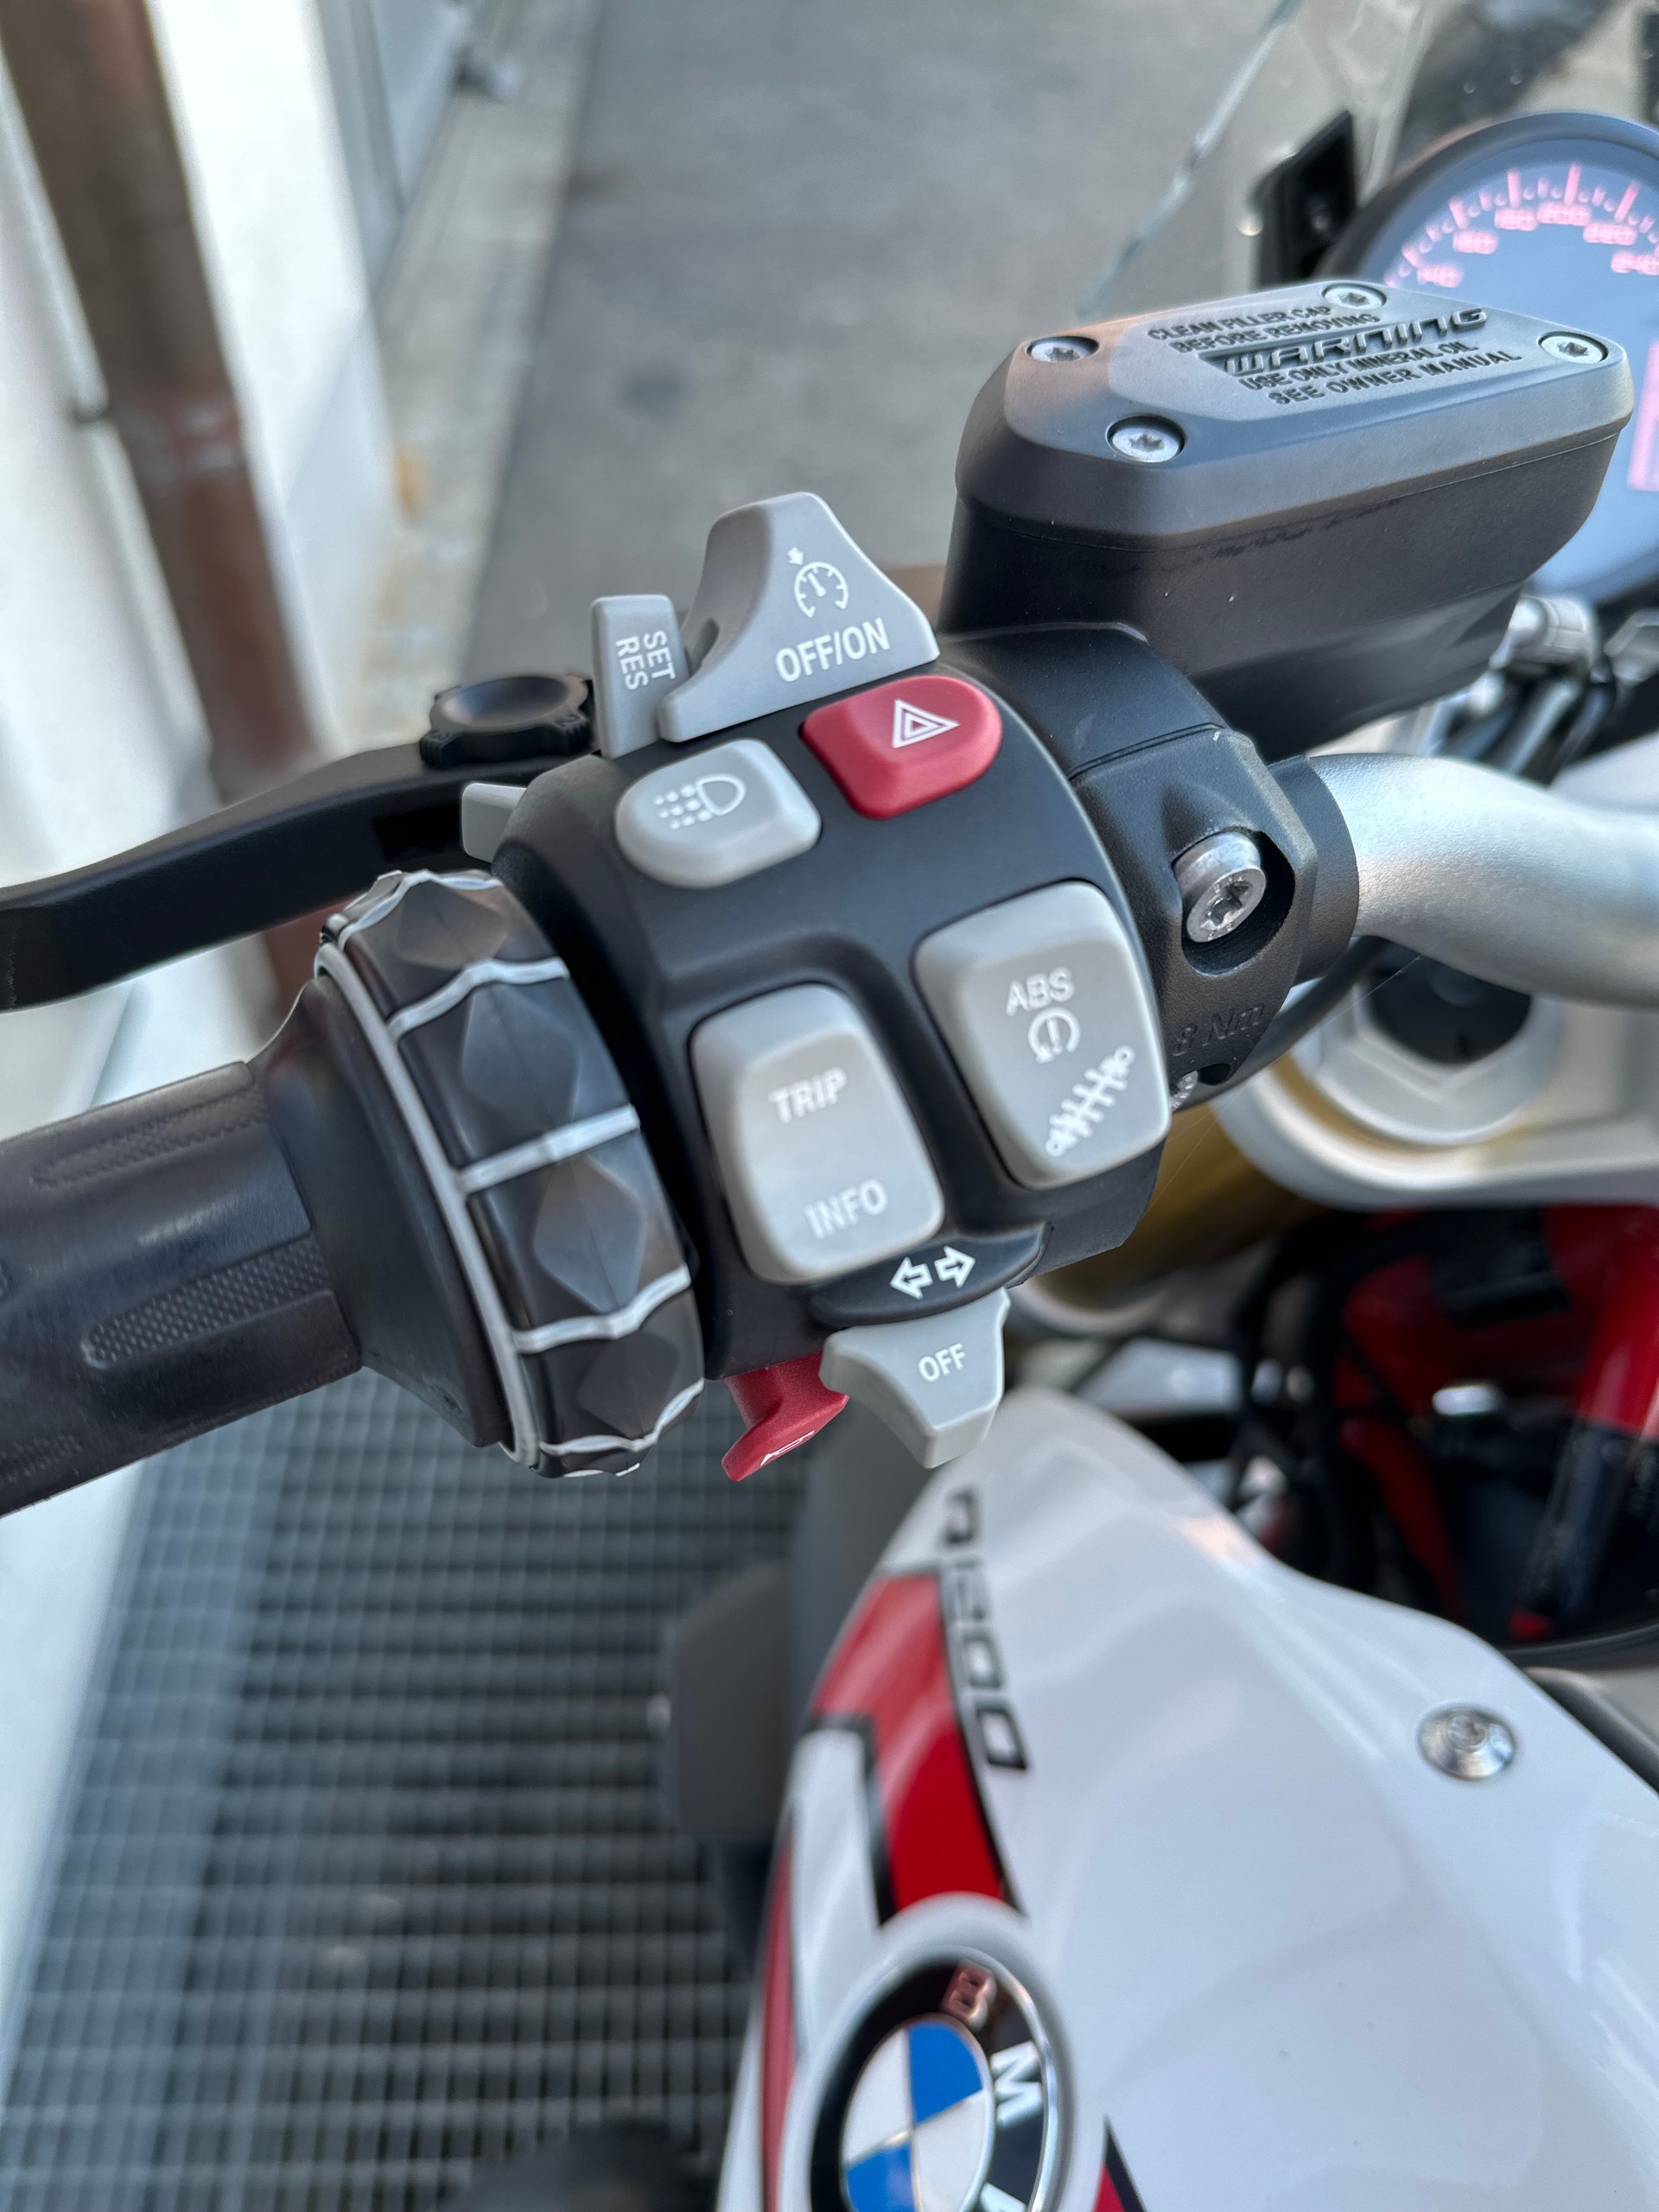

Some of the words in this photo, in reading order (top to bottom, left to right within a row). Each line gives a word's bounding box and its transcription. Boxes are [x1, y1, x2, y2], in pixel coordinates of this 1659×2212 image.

[1147, 321, 1223, 340] CLEAN
[1219, 311, 1294, 329] FILLER
[1290, 305, 1331, 321] CAP
[1168, 330, 1267, 353] BEFORE
[1263, 313, 1381, 338] REMOVING
[1224, 307, 1487, 378] WARNING
[1238, 372, 1293, 391] USE
[1288, 361, 1349, 382] ONLY
[1347, 346, 1443, 372] MINERAL
[1438, 340, 1479, 354] OIL
[1267, 385, 1325, 405] SEE
[1325, 368, 1422, 394] OWNER
[1416, 350, 1523, 376] MANUAL
[615, 636, 648, 690] RES
[643, 630, 677, 681] SET
[776, 617, 891, 683] OFF/ON
[1006, 966, 1074, 1016] ABS
[769, 1066, 847, 1124] TRIP
[804, 1178, 888, 1239] INFO
[918, 1343, 966, 1382] OFF
